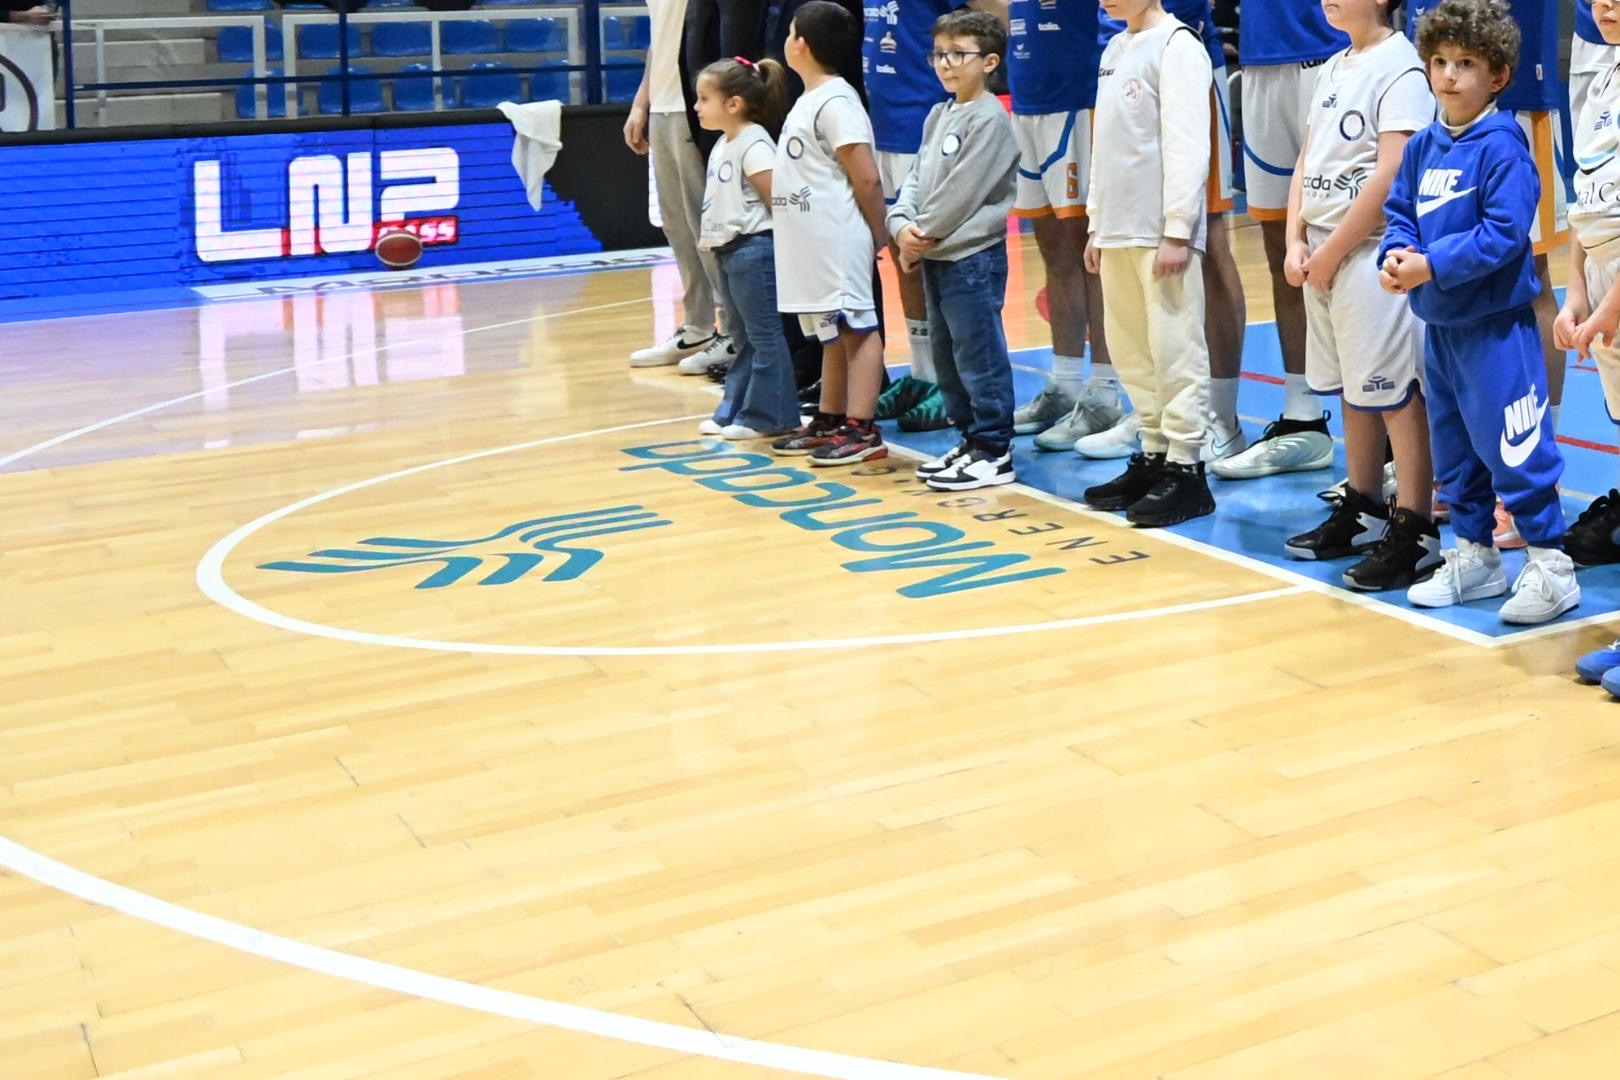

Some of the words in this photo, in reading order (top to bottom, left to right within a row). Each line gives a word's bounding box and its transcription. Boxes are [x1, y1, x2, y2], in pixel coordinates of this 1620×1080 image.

[194, 146, 460, 263] LNP
[1066, 162, 1079, 199] 6
[1419, 168, 1463, 197] NIKE
[618, 437, 1066, 599] Moncada
